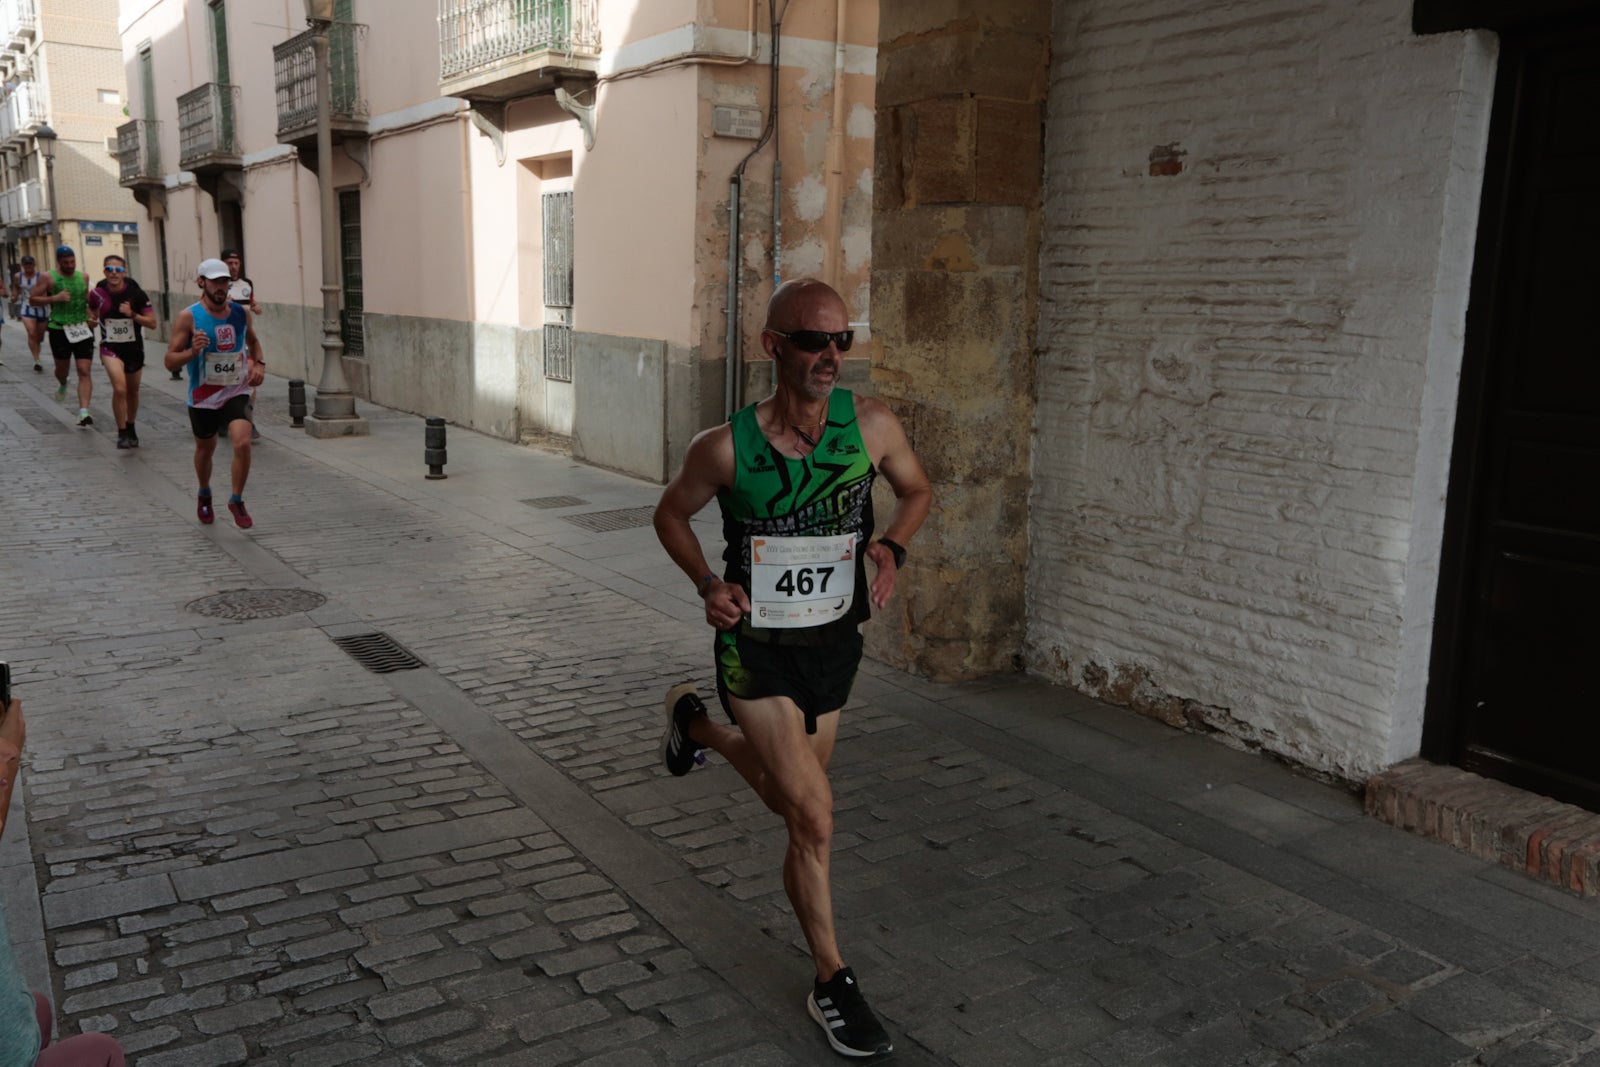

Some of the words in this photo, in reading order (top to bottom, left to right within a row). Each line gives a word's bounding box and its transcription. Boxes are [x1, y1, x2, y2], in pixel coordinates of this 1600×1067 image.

[112, 326, 128, 335] 380
[214, 363, 235, 373] 644
[775, 566, 835, 597] 467
